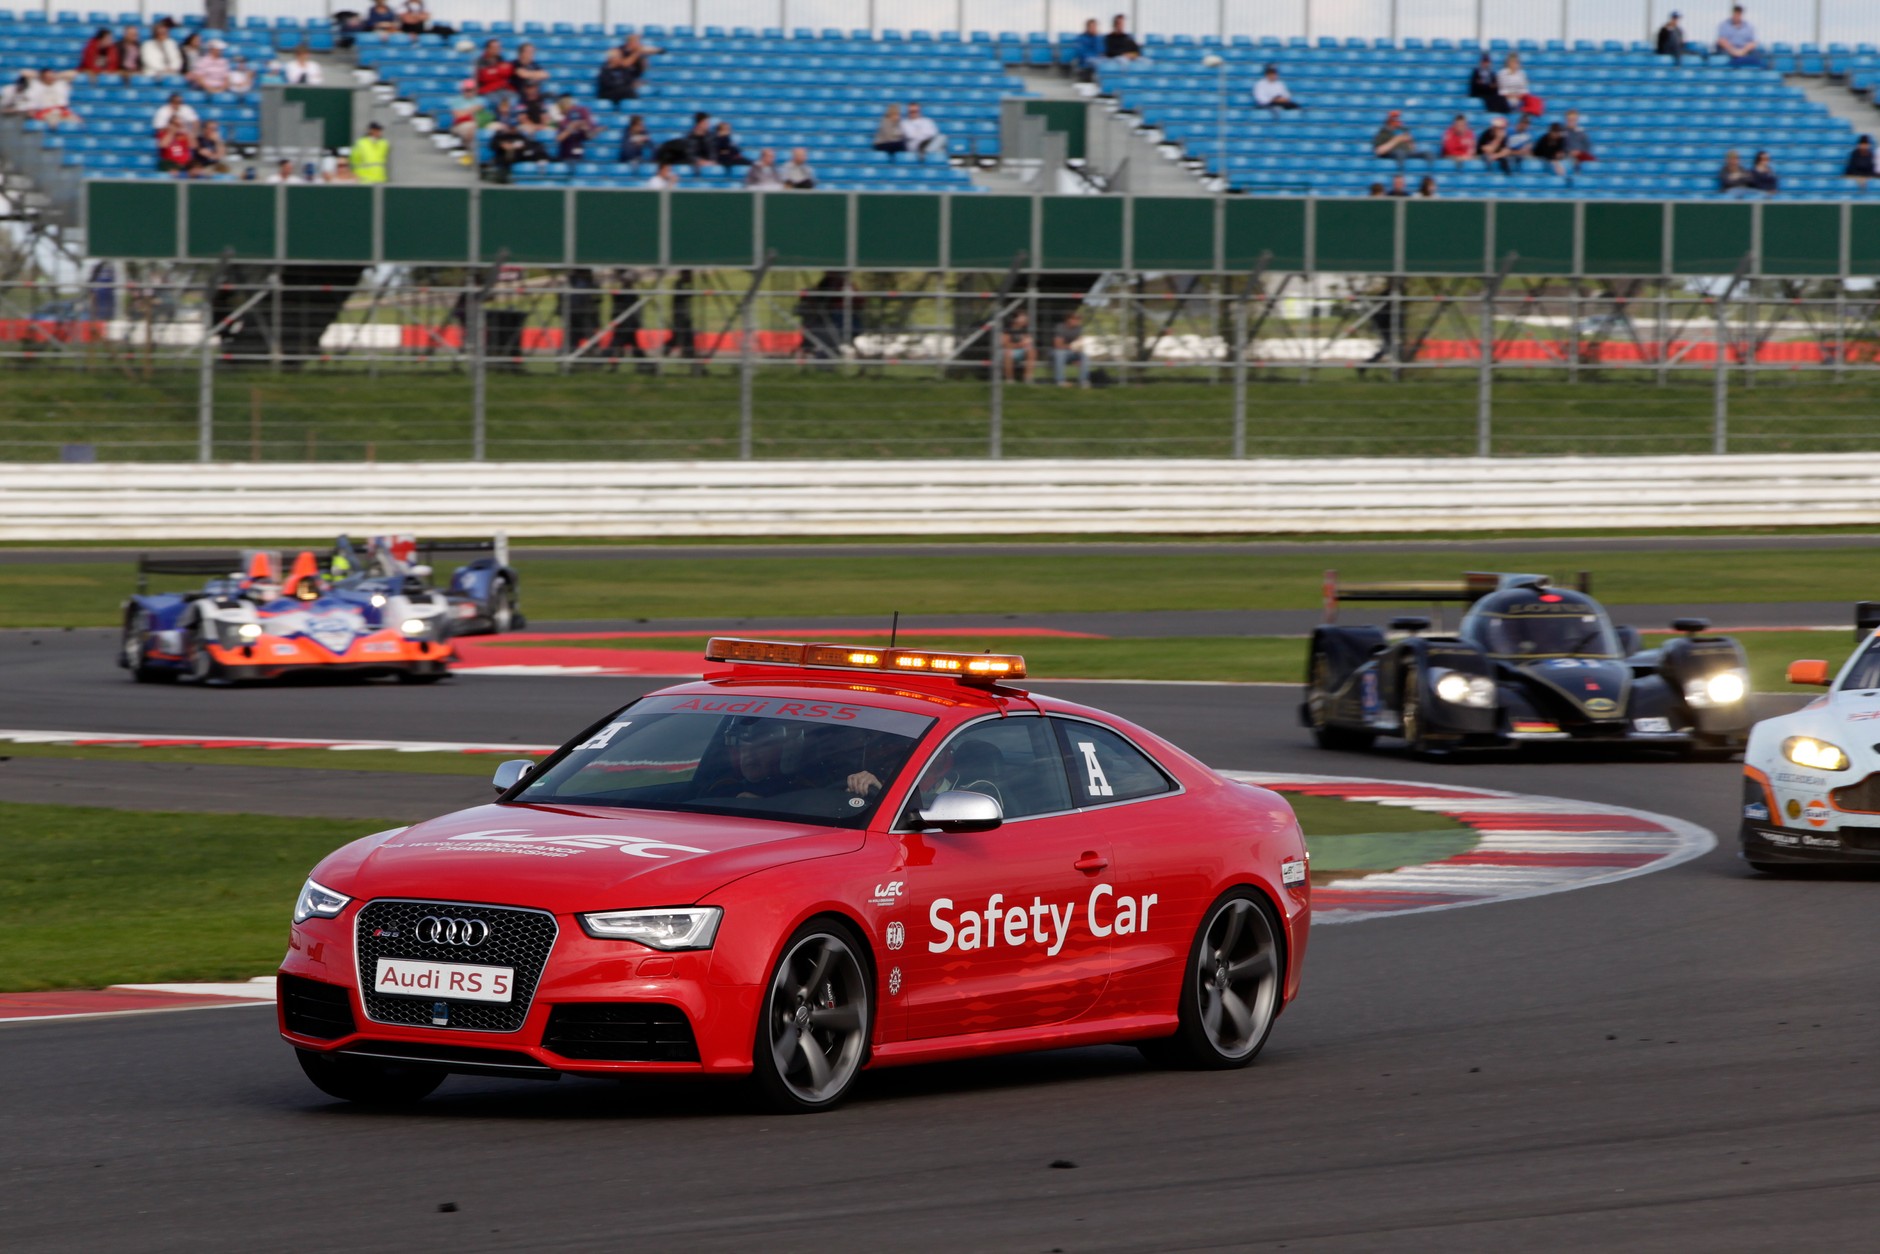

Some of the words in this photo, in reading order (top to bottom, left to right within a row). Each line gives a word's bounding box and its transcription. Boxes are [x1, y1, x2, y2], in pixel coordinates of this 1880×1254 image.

[671, 697, 769, 714] Audi
[775, 702, 862, 721] RS5
[572, 721, 633, 751] A
[1077, 742, 1114, 796] A
[874, 881, 904, 897] WEC
[928, 893, 1075, 957] Safety
[1087, 883, 1158, 938] Car
[887, 926, 904, 945] FIA
[380, 966, 440, 989] Audi
[449, 971, 483, 993] RS
[493, 975, 508, 995] 5
